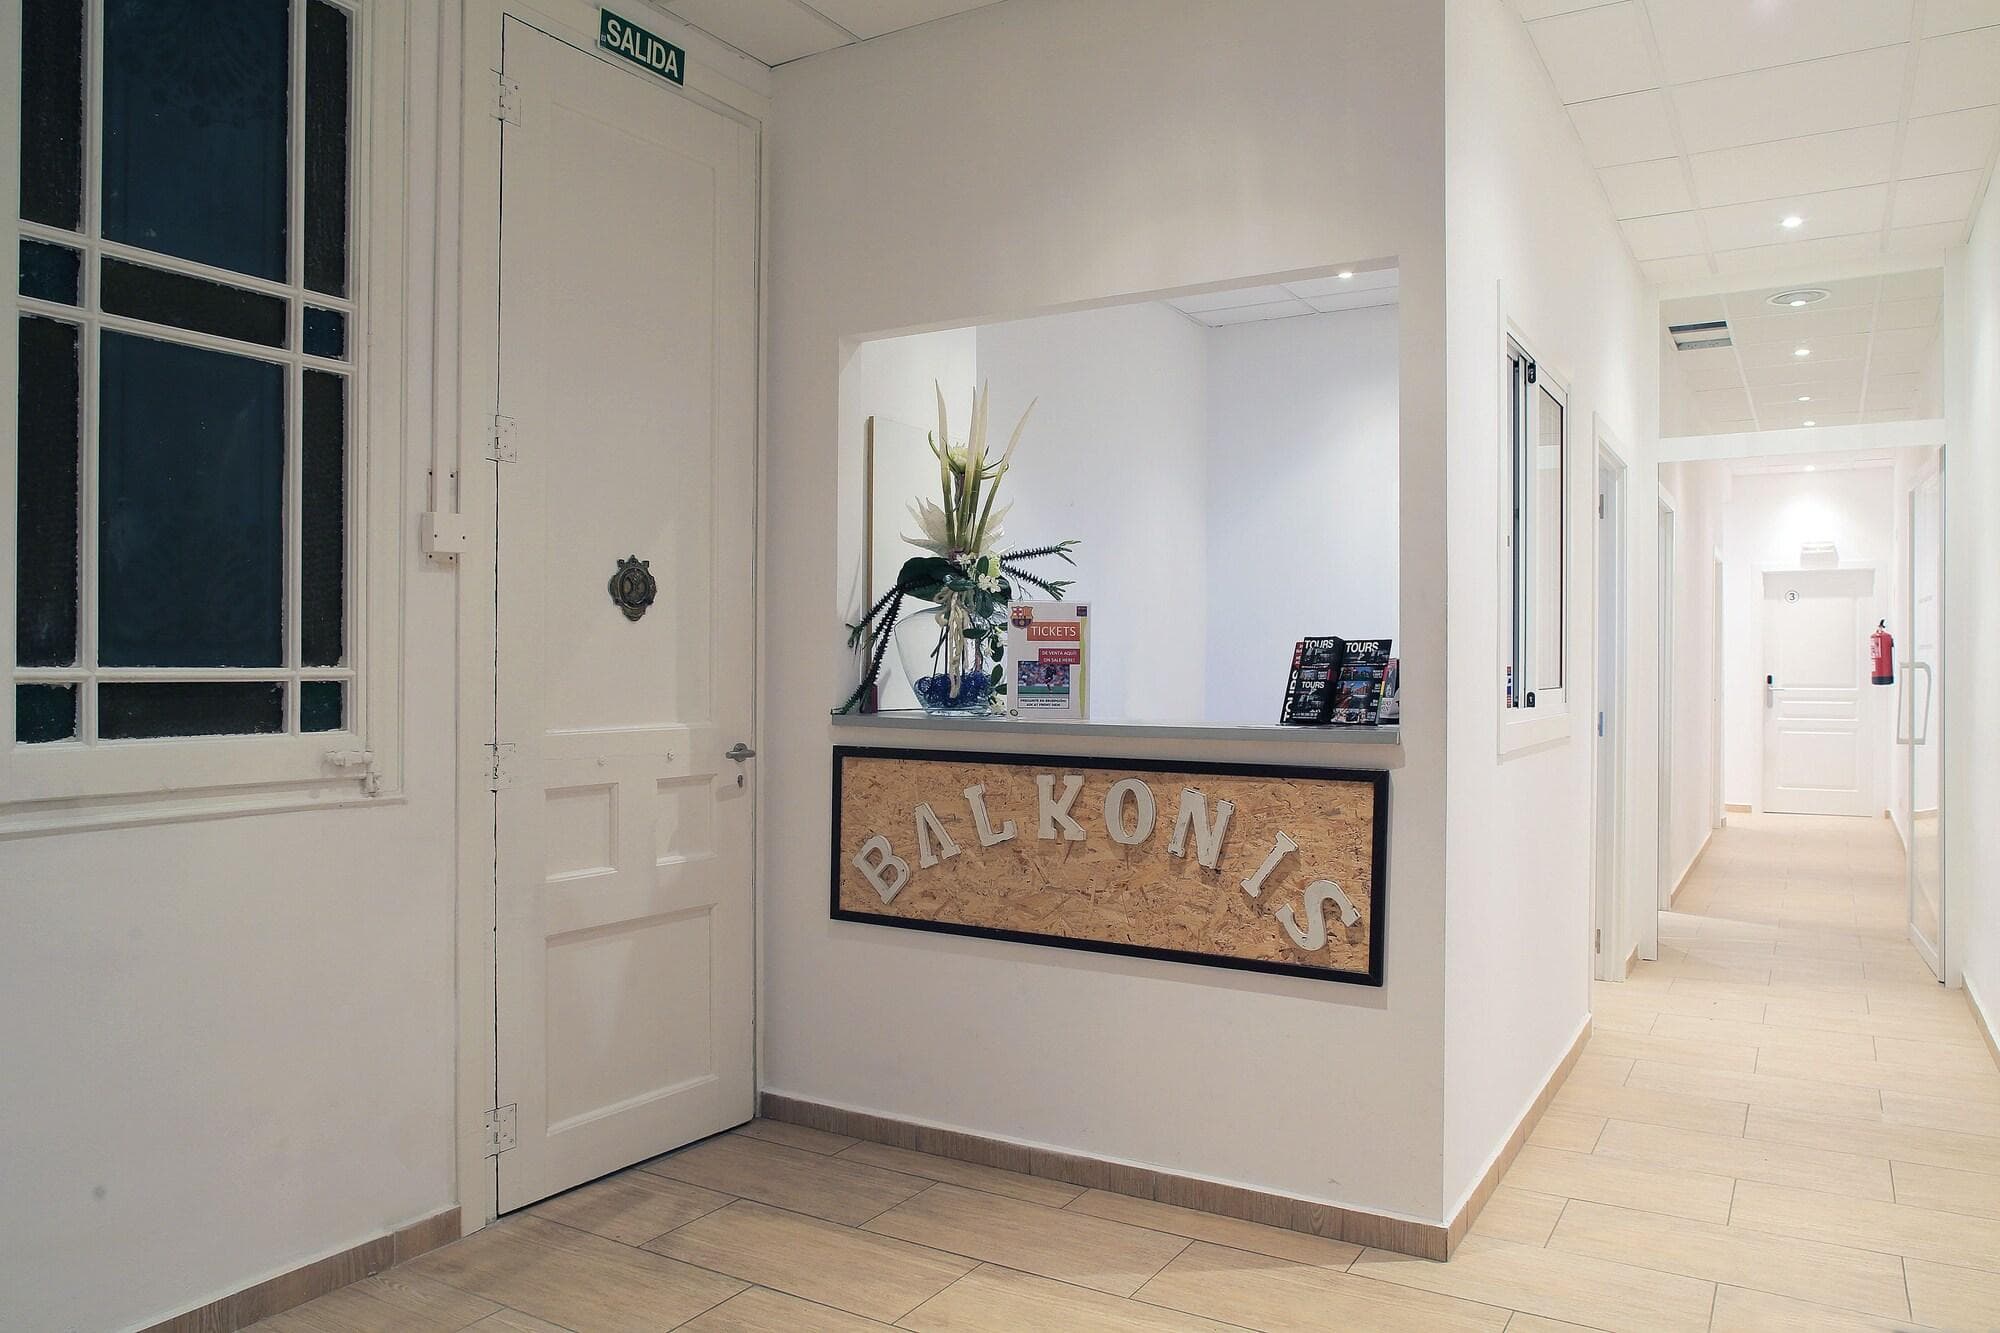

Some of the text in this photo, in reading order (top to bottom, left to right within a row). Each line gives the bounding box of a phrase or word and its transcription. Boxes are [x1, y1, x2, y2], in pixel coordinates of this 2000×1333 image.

[606, 19, 678, 78] SALIDA
[1030, 626, 1076, 637] TICKETS
[1304, 640, 1334, 649] TOURS
[1346, 642, 1379, 653] TOURS
[1302, 681, 1325, 690] TOURS
[852, 774, 1362, 952] BALKONIS
